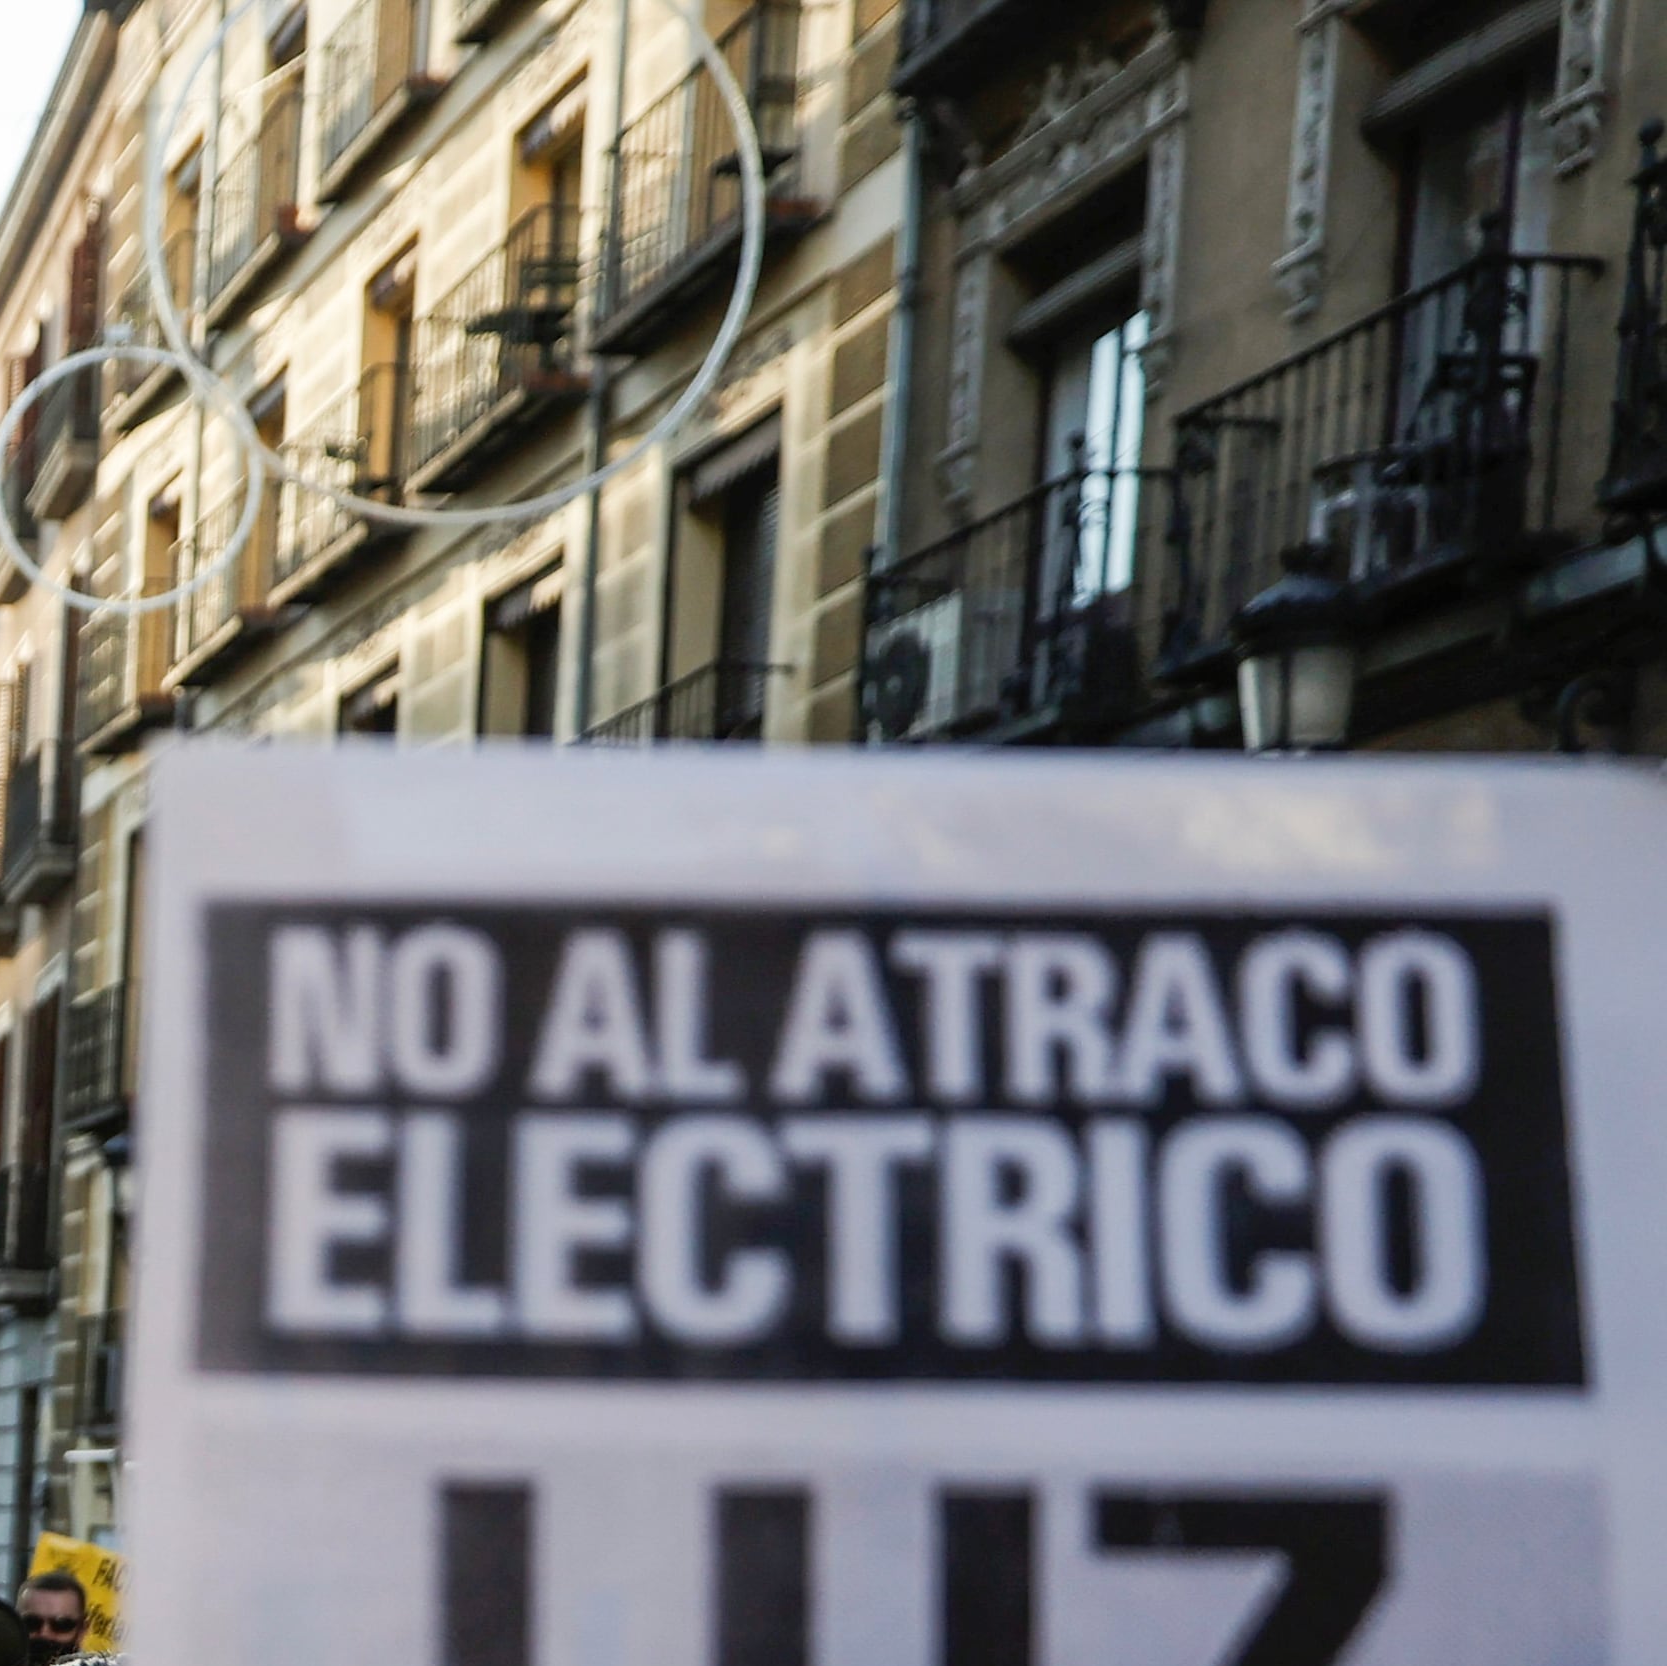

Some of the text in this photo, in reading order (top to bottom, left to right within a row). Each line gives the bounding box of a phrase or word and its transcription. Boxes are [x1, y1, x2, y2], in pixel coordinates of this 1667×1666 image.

[269, 922, 1479, 1106] NO AL ATRACO
[267, 1110, 1488, 1355] ELECTRICO
